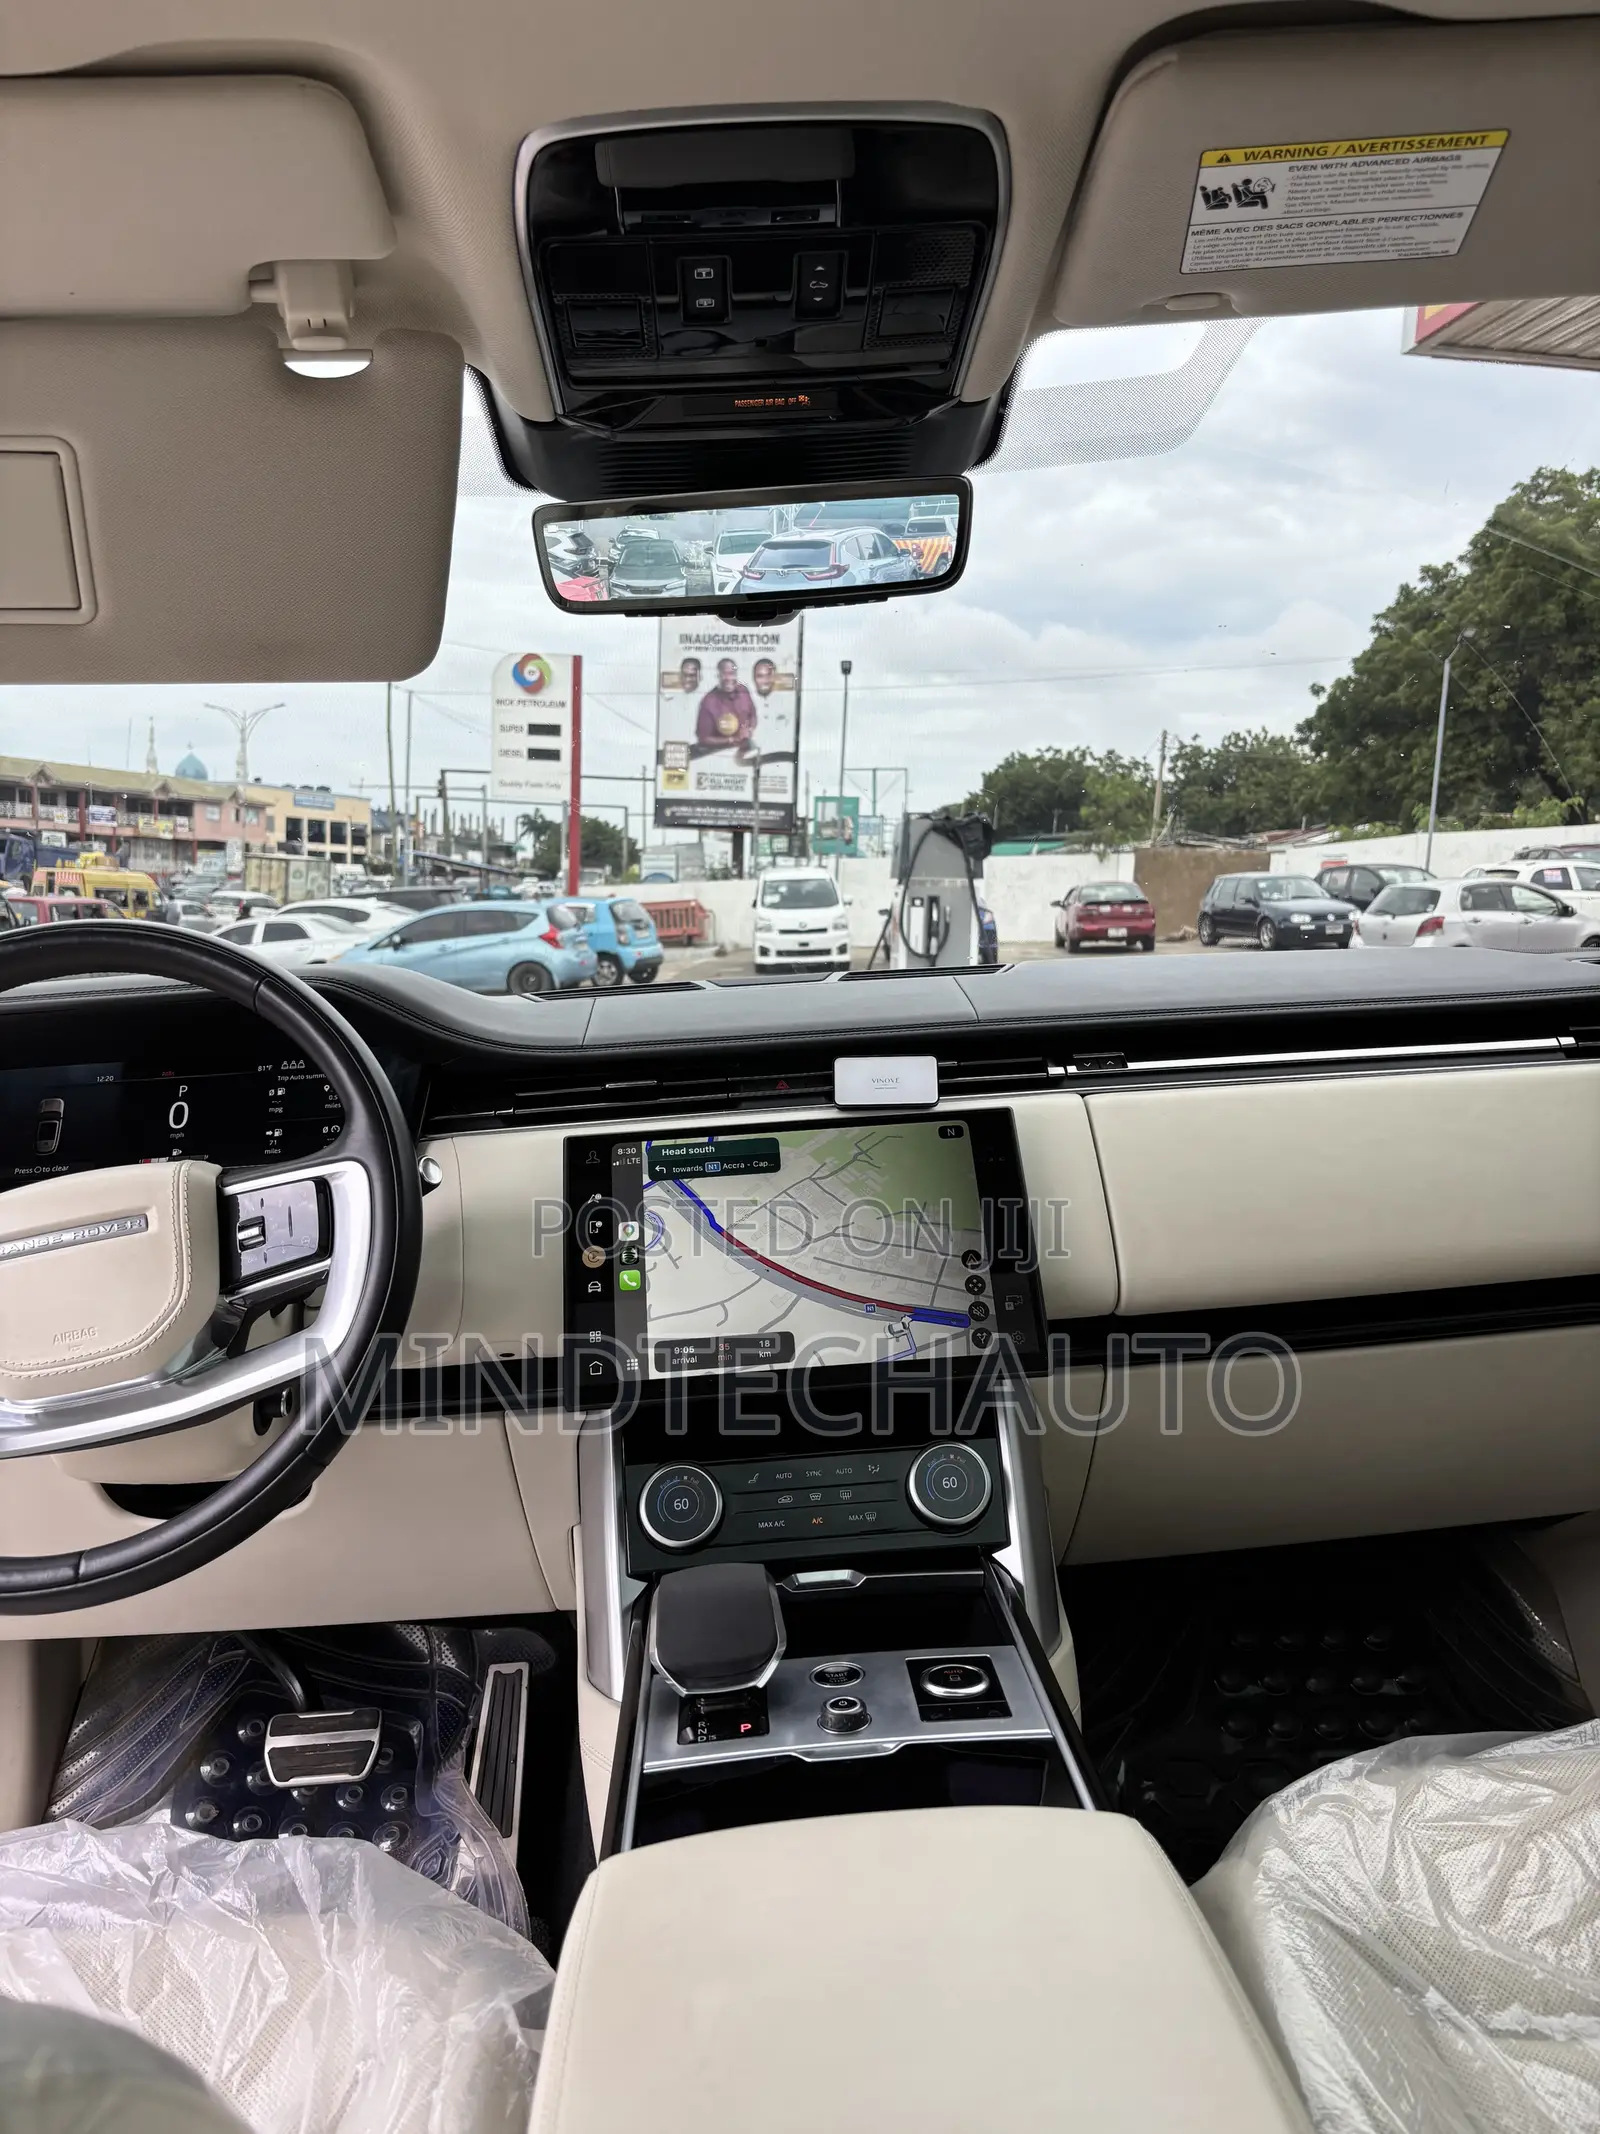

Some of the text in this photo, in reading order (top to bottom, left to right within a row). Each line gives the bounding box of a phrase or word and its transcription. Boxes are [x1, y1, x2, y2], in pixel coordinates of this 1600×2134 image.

[1244, 134, 1491, 161] WARNING / AVERTISSEMENT
[1288, 164, 1318, 173] EVEN
[1320, 162, 1348, 171] WITH
[1351, 157, 1410, 169] ADVANCED
[1411, 153, 1463, 165] AIRBAGS
[1190, 228, 1221, 237] MÊME
[1223, 226, 1250, 235] AVEC
[1252, 225, 1273, 233] DES
[1275, 222, 1304, 231] SACS
[1305, 217, 1375, 229] GONFLABLES
[734, 397, 797, 408] PASSENGER AIR BAG OFF
[679, 633, 780, 645] INAUGURATION
[516, 698, 567, 708] PETROLEUM
[499, 723, 524, 733] SUPER
[179, 1085, 188, 1097] P
[168, 1101, 189, 1129] 0
[947, 1127, 955, 1136] N
[617, 1147, 637, 1155] 8:30
[661, 1145, 715, 1156] Head south
[627, 1157, 641, 1165] LTE
[14, 1166, 33, 1175] Press
[51, 1164, 69, 1173] clear
[672, 1164, 703, 1173] towards
[722, 1161, 745, 1170] Accra
[71, 1218, 142, 1241] ROVER
[52, 1326, 98, 1345] AIRBAG
[718, 1343, 730, 1351] 35
[759, 1340, 770, 1348] 18
[674, 1346, 695, 1354] 9:05
[758, 1350, 771, 1358] km
[672, 1355, 698, 1365] arrival
[717, 1354, 733, 1362] min
[942, 1476, 958, 1489] 60
[674, 1498, 689, 1510] 60
[774, 1520, 785, 1528] A/C
[740, 1723, 751, 1732] P
